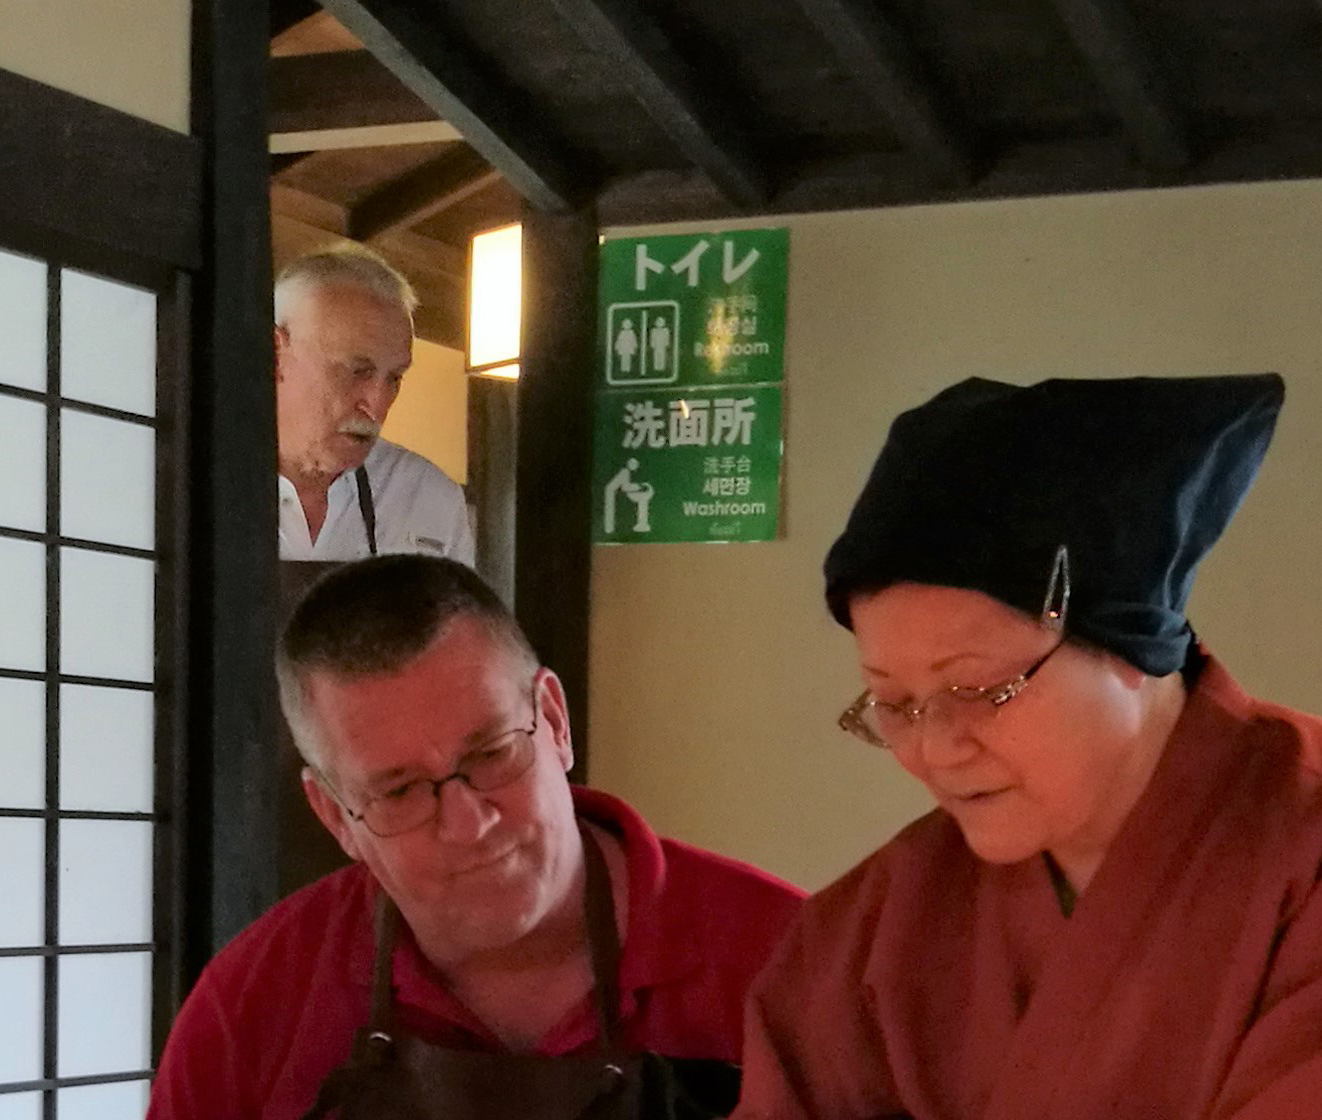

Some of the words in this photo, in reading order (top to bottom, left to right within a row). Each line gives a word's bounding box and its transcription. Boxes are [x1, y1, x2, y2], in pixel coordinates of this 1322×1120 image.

[636, 240, 760, 291] トイレ
[693, 342, 769, 357] Reroom
[622, 397, 756, 447] 洗面所
[703, 476, 751, 496] 세면장
[683, 500, 766, 516] Washroom
